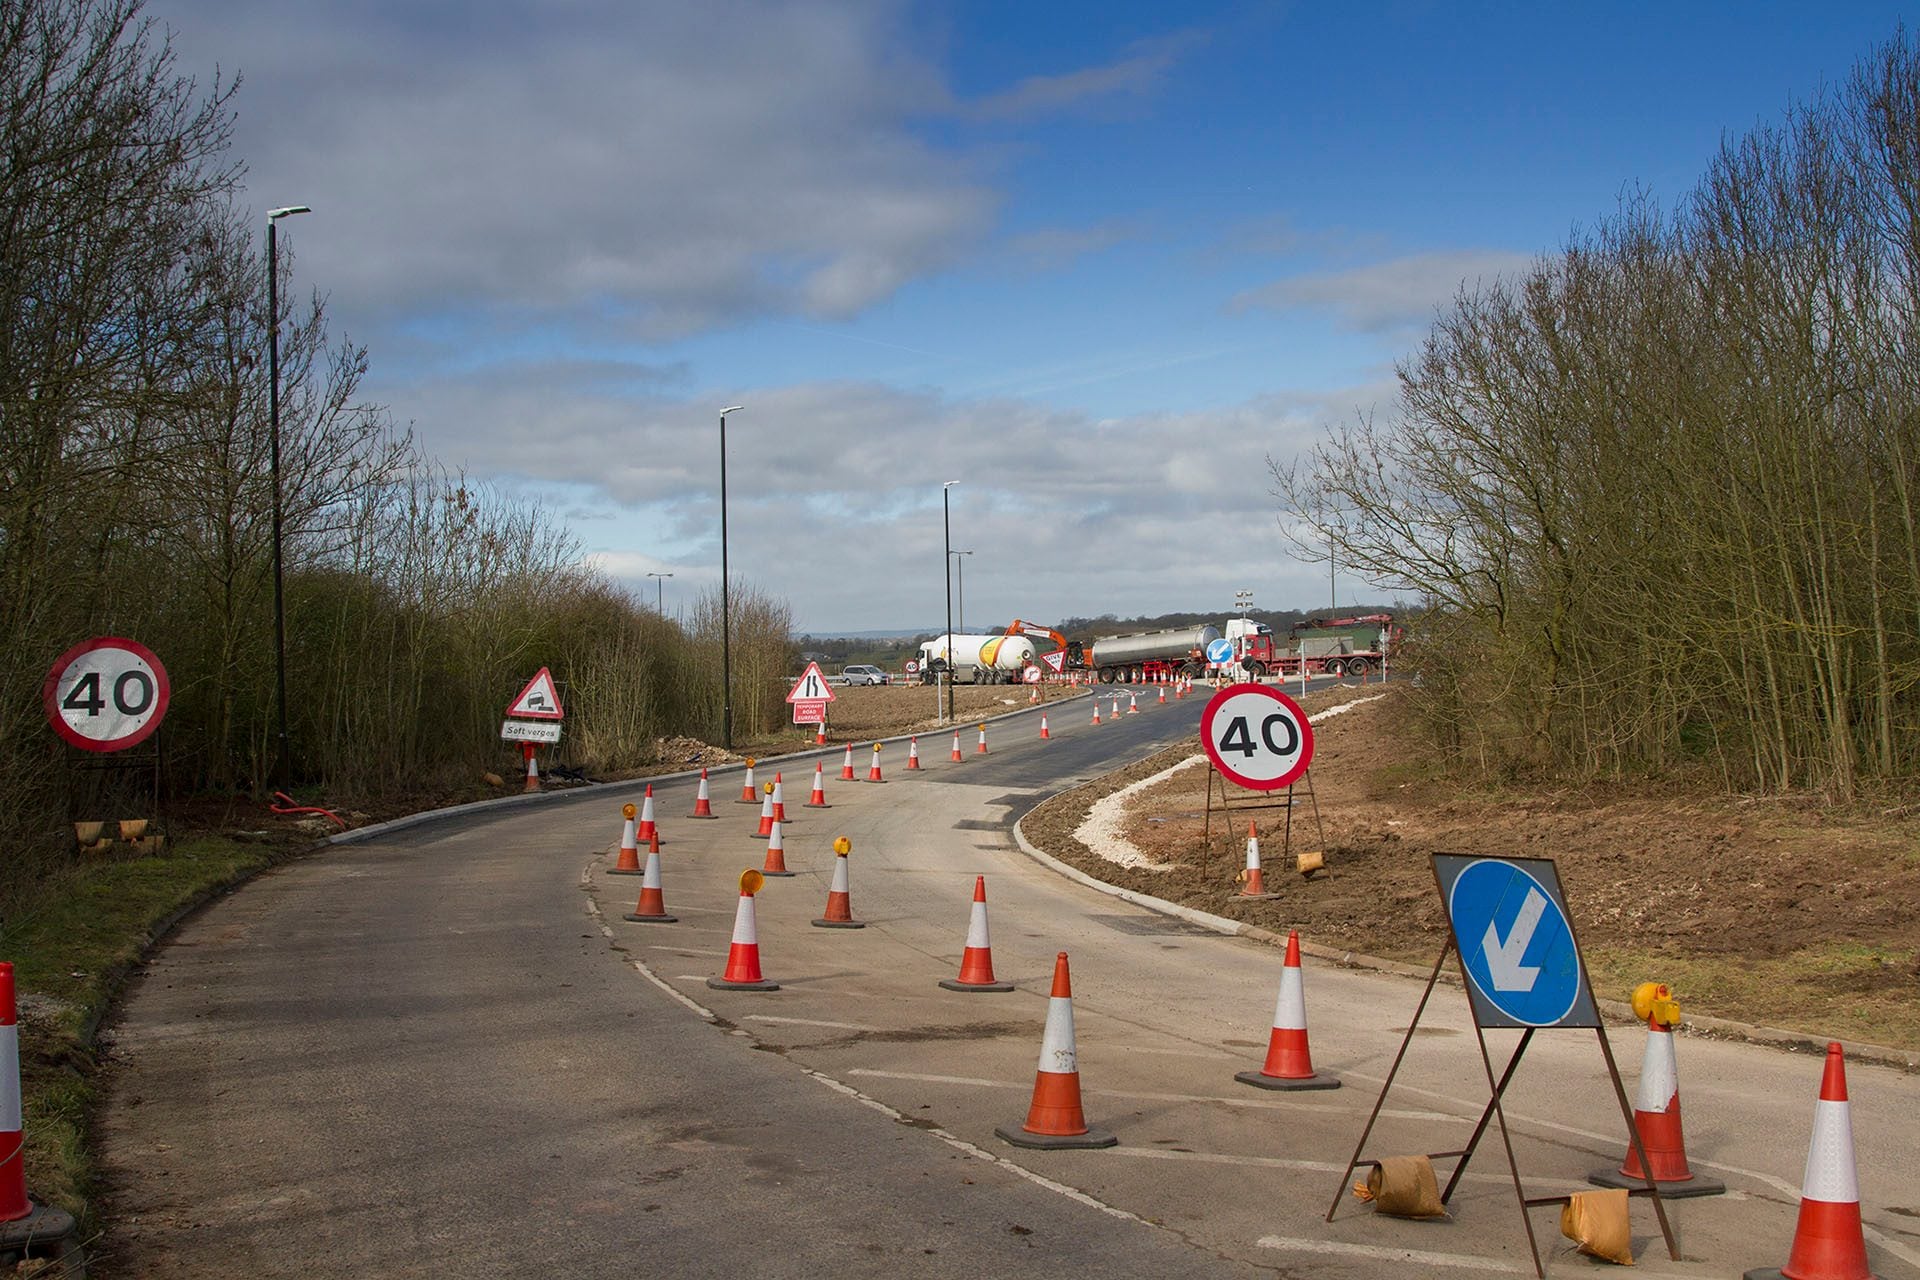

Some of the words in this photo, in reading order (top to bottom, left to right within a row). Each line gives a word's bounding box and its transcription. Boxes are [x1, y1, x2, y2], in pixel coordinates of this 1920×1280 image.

[63, 670, 154, 716] 40
[507, 726, 526, 735] Soft
[527, 729, 555, 737] verges
[1219, 713, 1299, 757] 40
